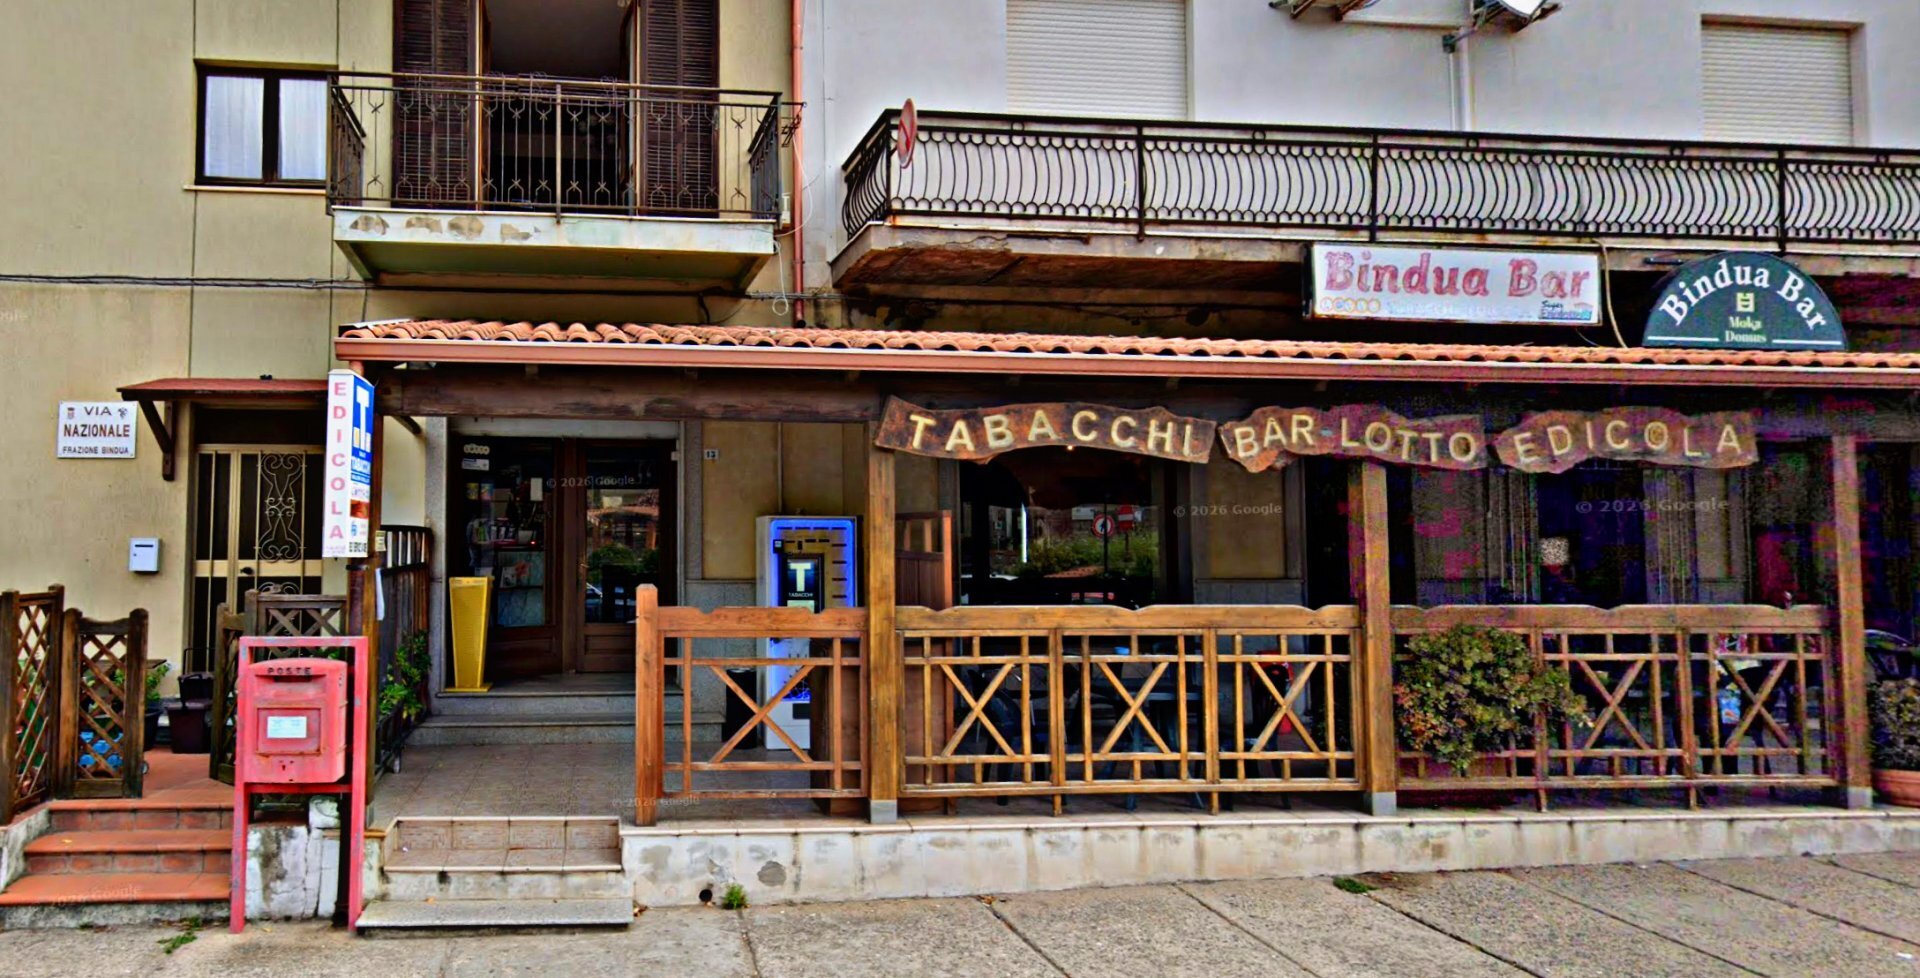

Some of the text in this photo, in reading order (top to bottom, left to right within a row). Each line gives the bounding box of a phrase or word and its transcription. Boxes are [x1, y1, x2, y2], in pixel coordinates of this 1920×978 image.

[1324, 250, 1590, 299] Bindua Bar
[1658, 258, 1827, 331] Bindua Bar
[63, 424, 131, 438] NAZIONALE
[84, 406, 112, 416] VIA
[909, 409, 1193, 456] TABACCHI
[62, 446, 99, 455] FRAZIONE
[329, 381, 347, 539] EDICOLA
[706, 450, 717, 460] 13
[1234, 414, 1477, 463] BAR LOTTO
[1513, 420, 1742, 463] EDICOLA
[267, 667, 312, 675] POSTE
